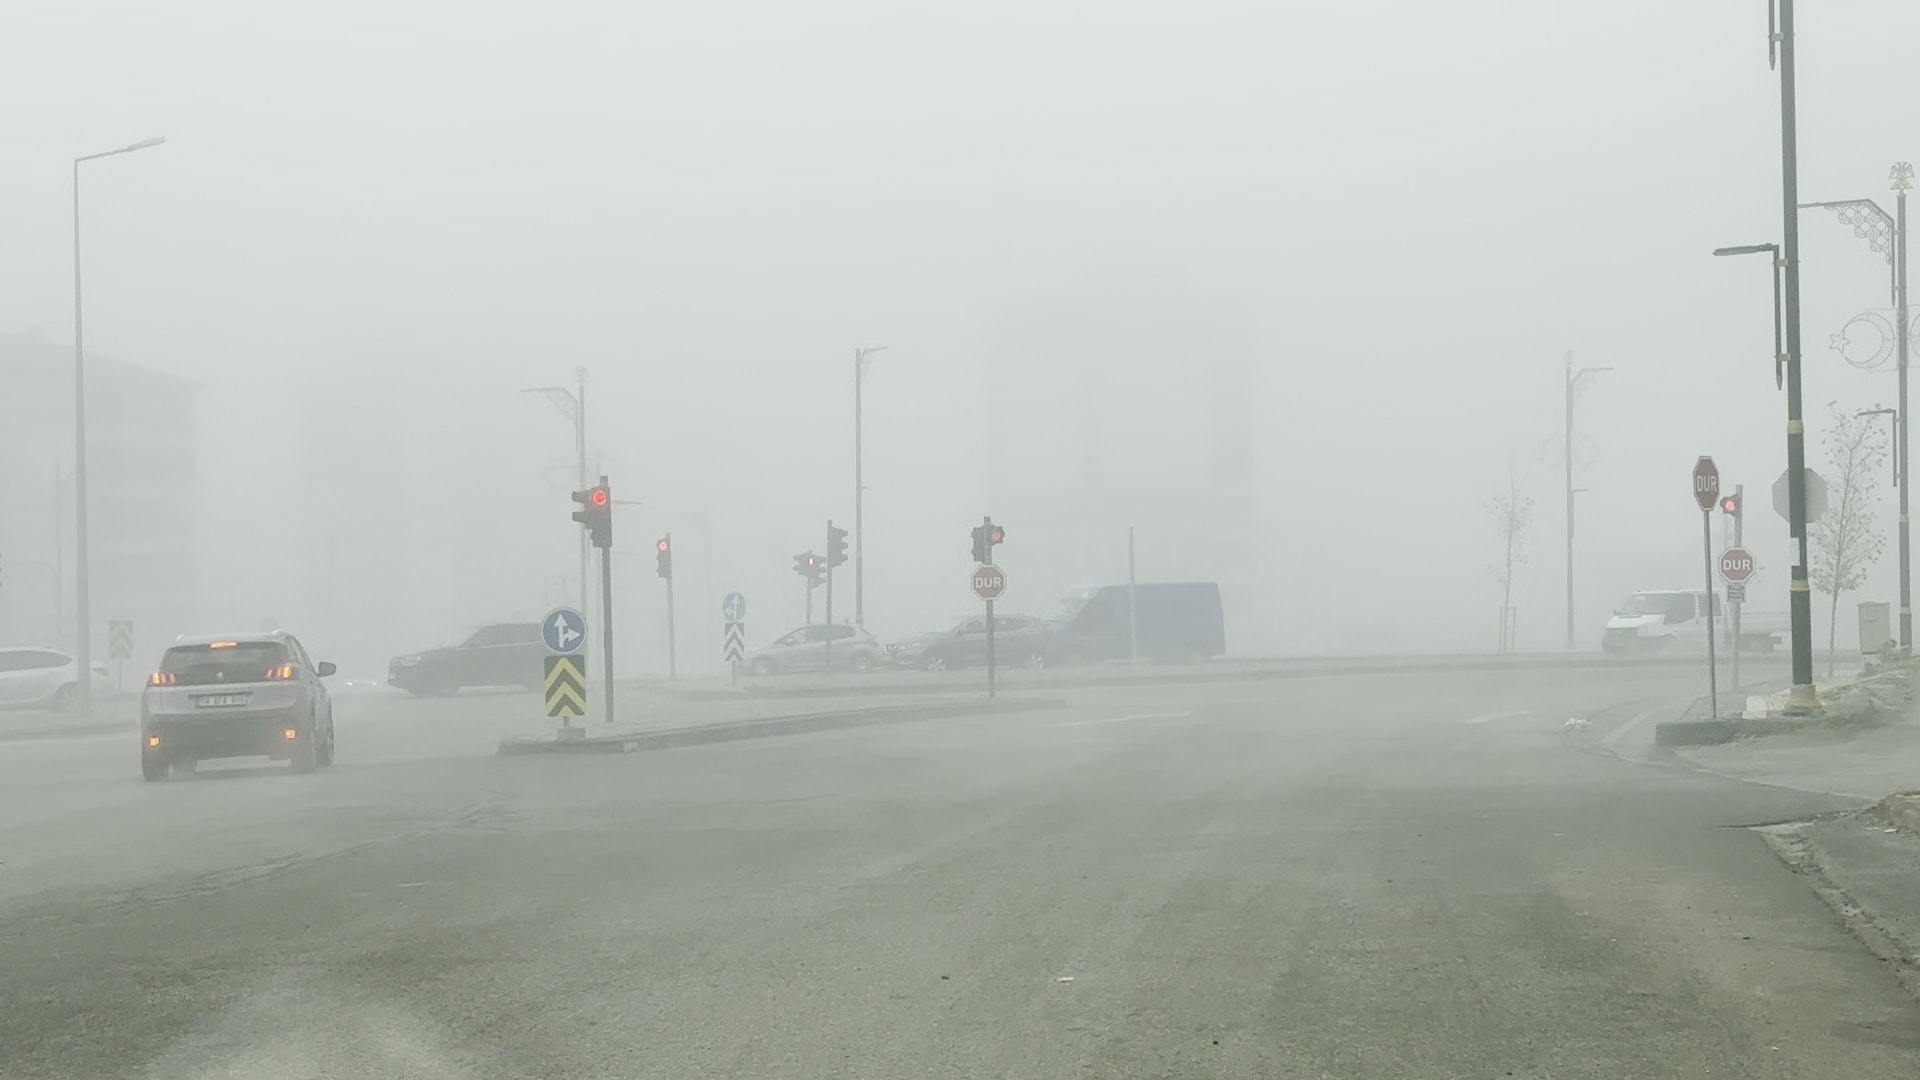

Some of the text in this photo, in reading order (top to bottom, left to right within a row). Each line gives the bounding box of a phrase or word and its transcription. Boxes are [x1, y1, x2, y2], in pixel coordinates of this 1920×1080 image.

[1696, 475, 1717, 492] DUR
[1724, 560, 1750, 570] DUR
[975, 577, 1001, 588] DUR
